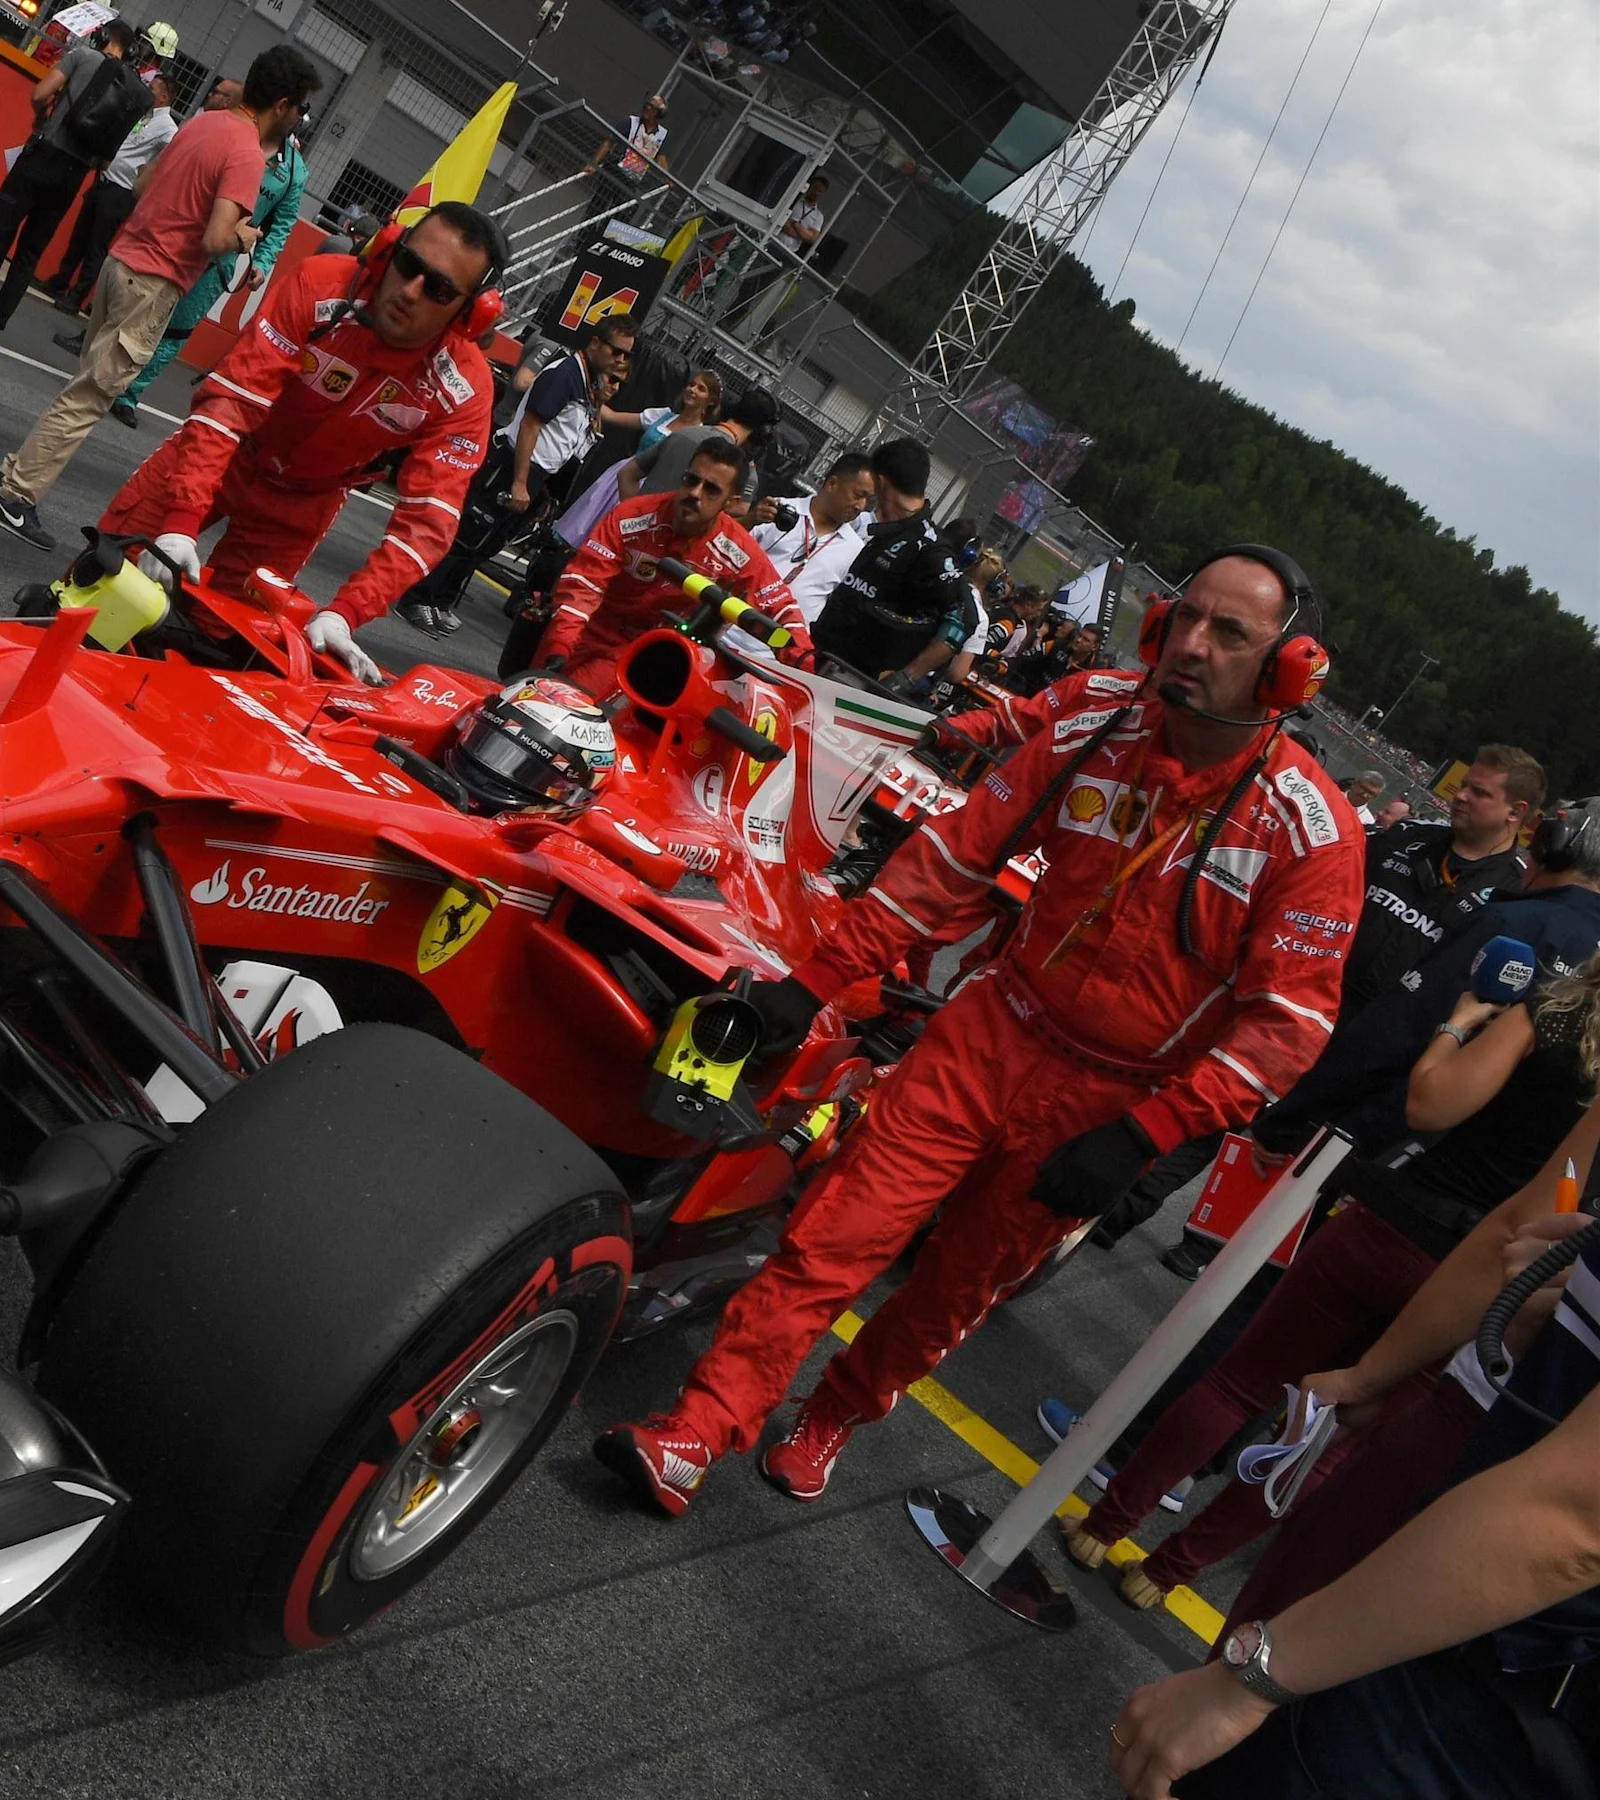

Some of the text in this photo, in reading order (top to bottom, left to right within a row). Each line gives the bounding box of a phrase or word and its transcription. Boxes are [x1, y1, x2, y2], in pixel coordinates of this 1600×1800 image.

[607, 248, 645, 268] ALONSO
[558, 270, 640, 332] 14
[323, 373, 350, 393] ups
[1102, 589, 1117, 625] DANIIL
[411, 677, 460, 712] Ray-Ban
[519, 733, 554, 761] HUBLOT
[1281, 771, 1330, 836] KASPERSKY
[667, 841, 721, 873] HUBLOT
[1391, 861, 1413, 877] UBS
[227, 867, 391, 925] Santander
[1457, 898, 1474, 914] BO
[1283, 909, 1354, 934] WEICHAI
[1501, 970, 1529, 982] NEWS
[1505, 965, 1532, 977] BAND
